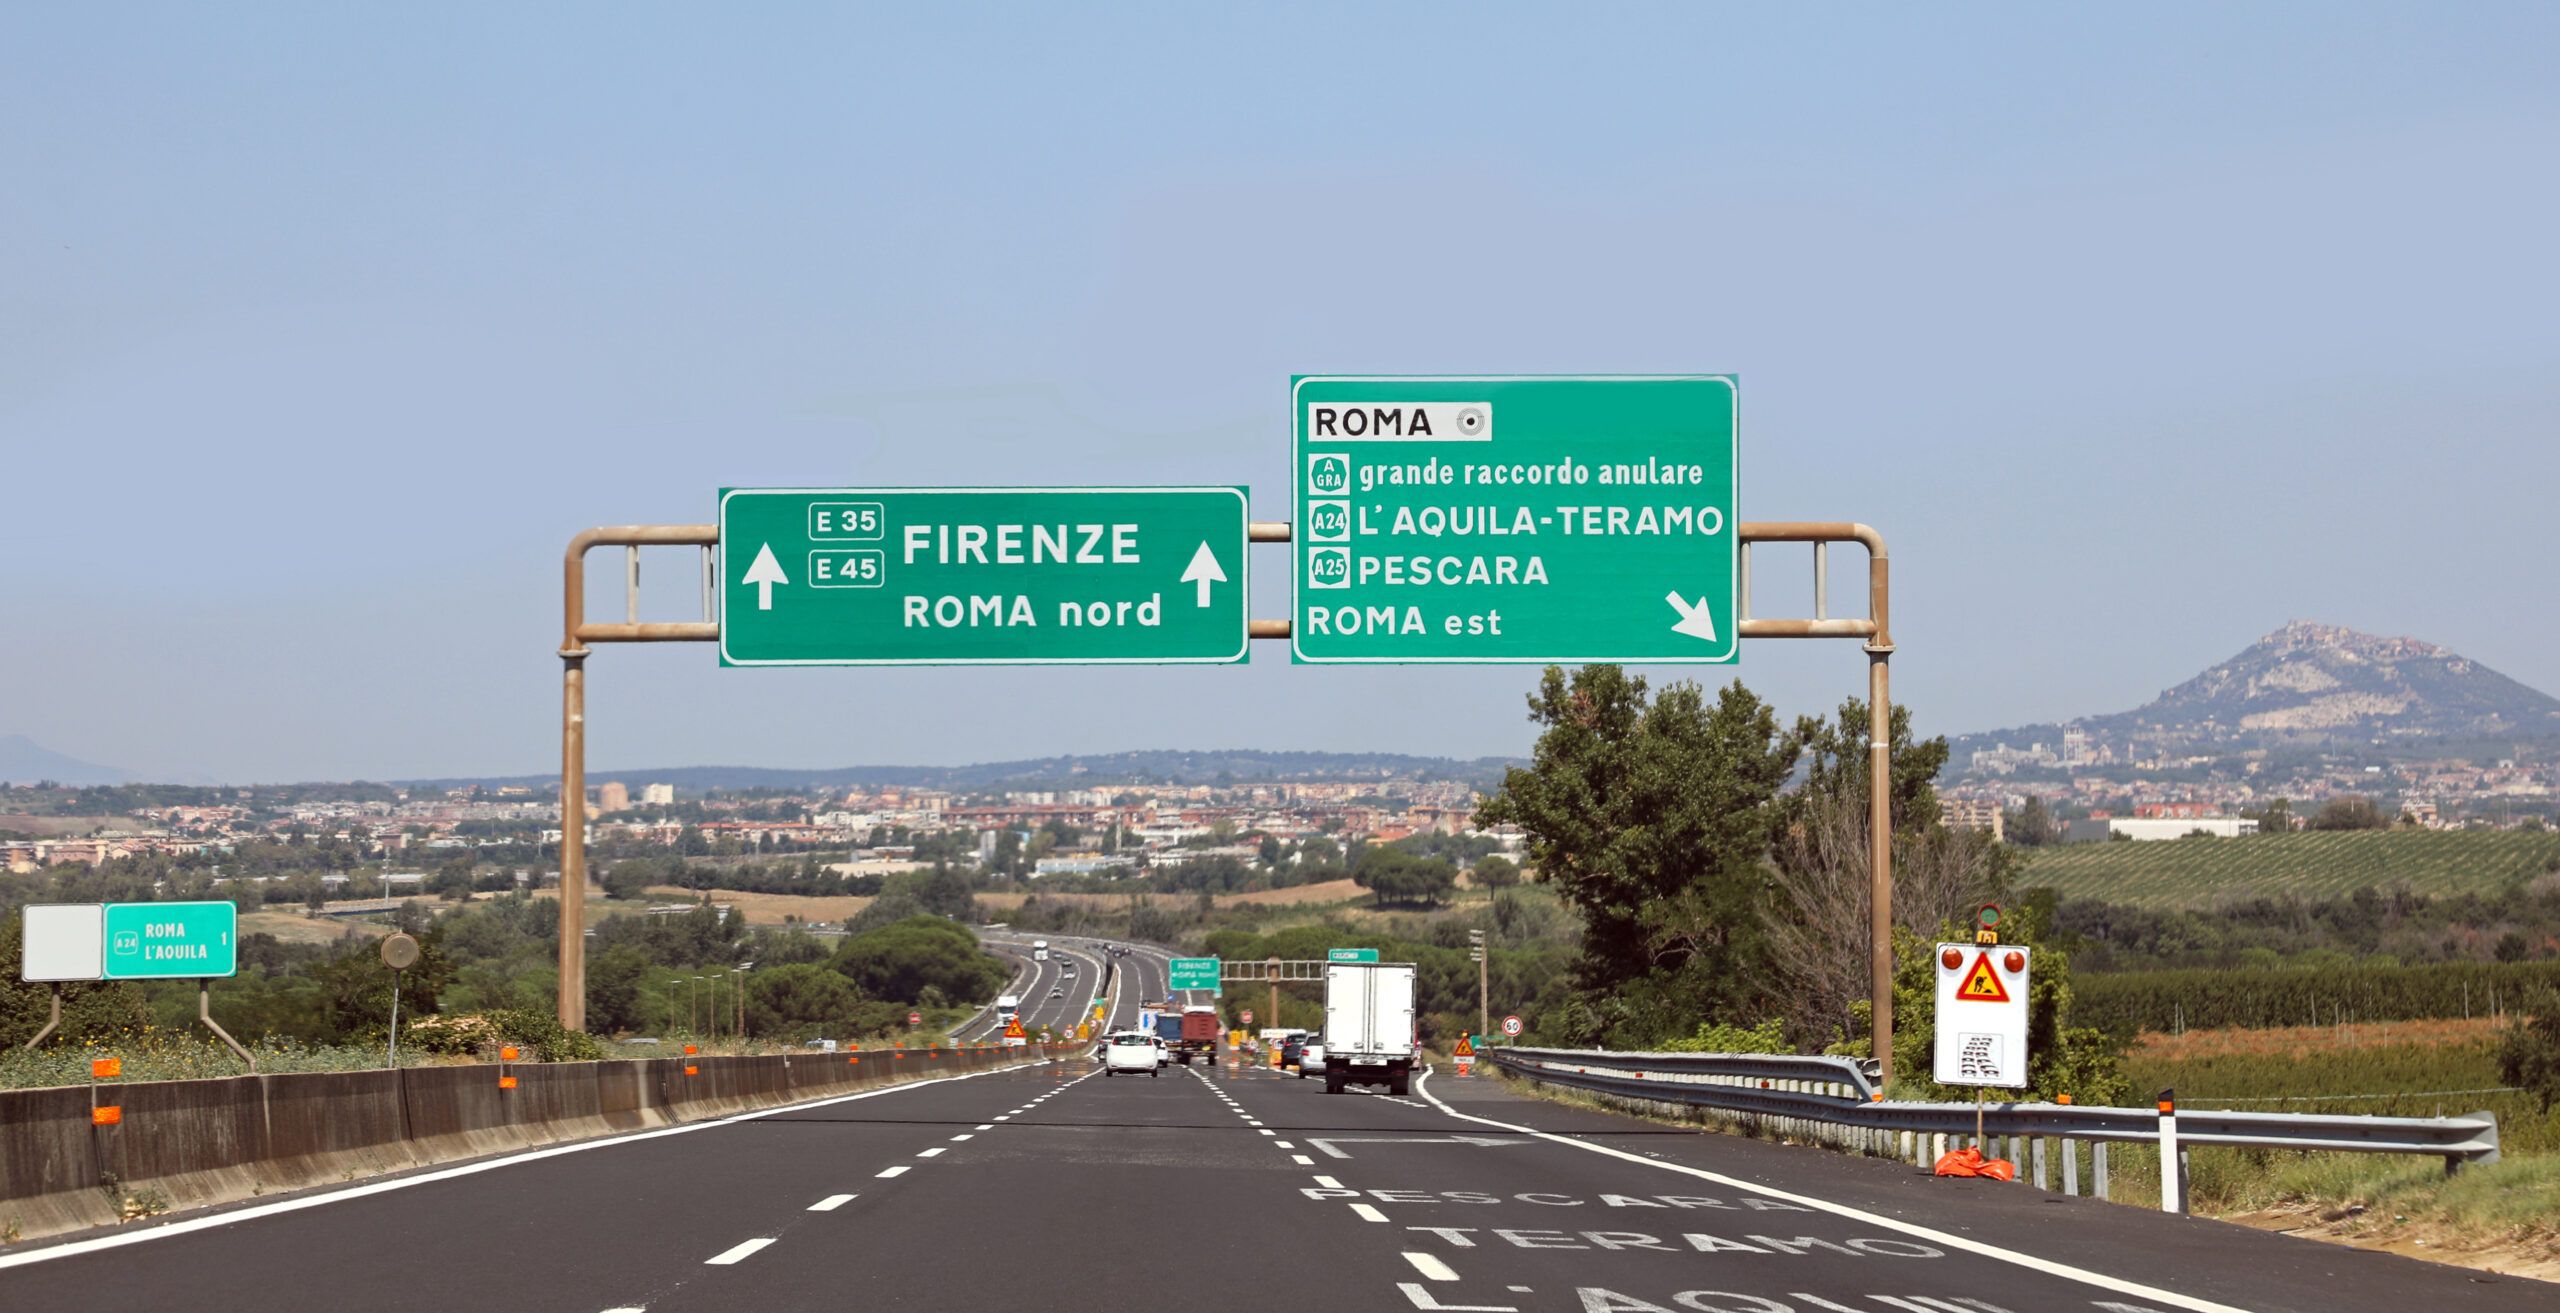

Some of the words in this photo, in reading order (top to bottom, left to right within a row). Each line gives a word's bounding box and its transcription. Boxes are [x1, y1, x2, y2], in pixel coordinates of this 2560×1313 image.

[1315, 408, 1433, 437] ROMA
[1323, 459, 1335, 472] A
[1359, 456, 1454, 492] grande
[1464, 456, 1589, 485] raccordo
[1598, 456, 1703, 485] anulare
[1316, 473, 1342, 487] GRA
[1314, 512, 1345, 530] A24
[904, 523, 1140, 564] FIRENZE
[1313, 558, 1345, 576] A25
[1359, 556, 1549, 586] PESCARA
[904, 594, 1037, 628] ROMA
[1059, 592, 1161, 627] nord
[1308, 606, 1427, 635] ROMA
[1444, 608, 1502, 636] est
[145, 922, 185, 938] ROMA
[221, 931, 227, 946] 1
[145, 944, 207, 960] L'AQUILA
[1506, 1021, 1519, 1031] 60
[1299, 1188, 1815, 1212] PESCARA
[1406, 1226, 1945, 1258] TERAMO
